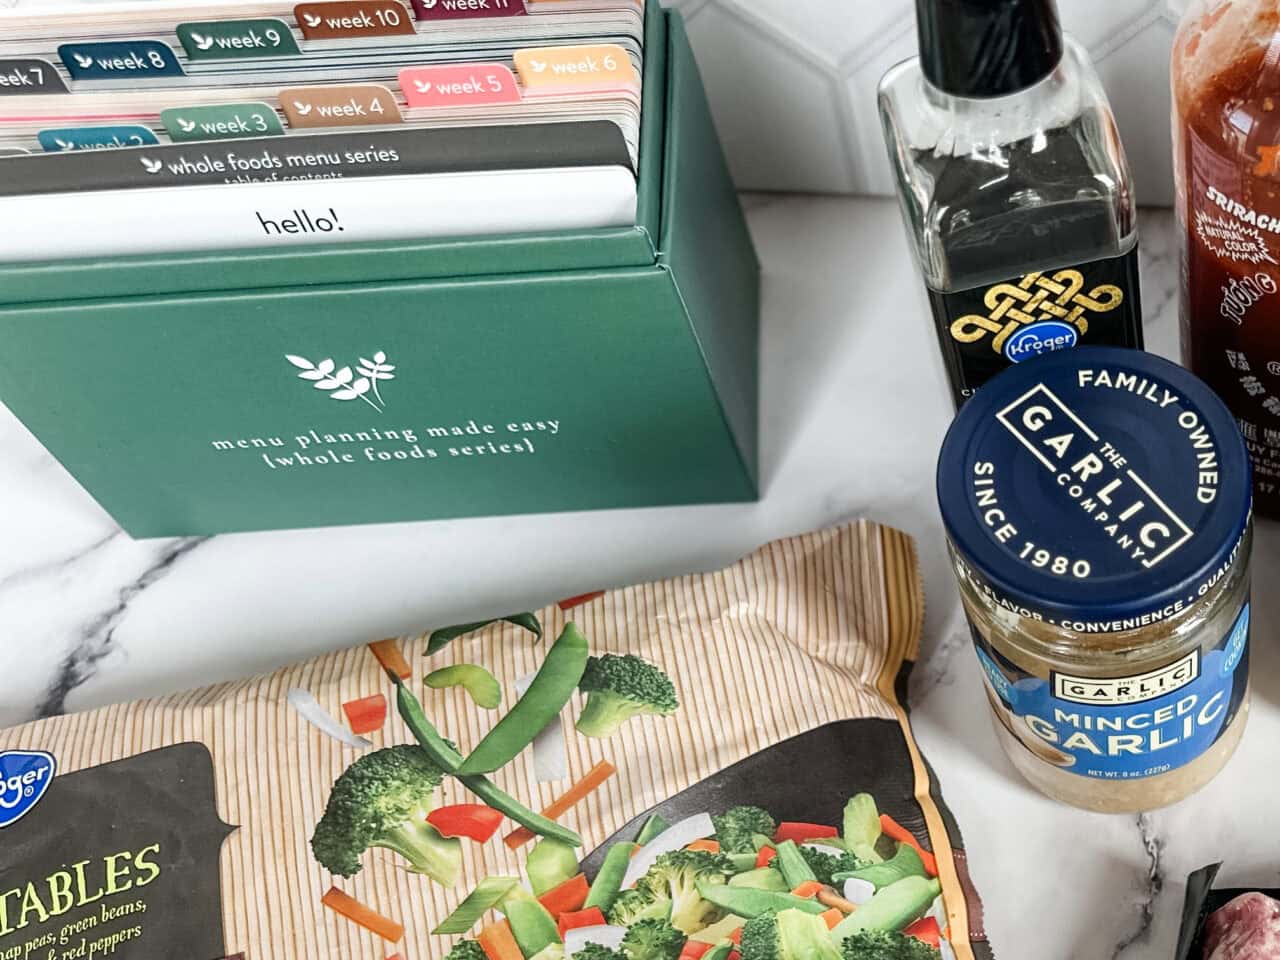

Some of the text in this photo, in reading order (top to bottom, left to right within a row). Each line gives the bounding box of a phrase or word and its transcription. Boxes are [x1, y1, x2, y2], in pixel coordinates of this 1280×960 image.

[325, 9, 401, 30] week 10
[215, 30, 281, 50] week 9
[97, 52, 165, 71] week 8
[551, 54, 617, 74] week 6
[0, 67, 43, 86] eek 7
[435, 75, 502, 96] week 5
[316, 98, 384, 118] week 4
[200, 114, 268, 135] week 3
[167, 145, 400, 175] whole foods menu series
[256, 208, 344, 235] hello!
[1224, 240, 1260, 252] COLOR
[1010, 332, 1073, 355] Kroger
[212, 418, 561, 451] menu planning made easy
[1077, 369, 1179, 409] FAMILY
[1177, 411, 1218, 504] OWNED
[261, 437, 537, 469] (whole foods series)
[1099, 442, 1128, 470] THE
[1022, 404, 1171, 549] GARLIC
[973, 461, 1019, 543] SINCE
[1018, 542, 1091, 579] 1980
[1056, 473, 1145, 560] COMPANY
[1061, 601, 1185, 633] CONVENIENCE
[1070, 668, 1185, 697] GARLIC
[1023, 690, 1225, 757] GARLIC
[1053, 694, 1199, 731] MINCED
[1088, 768, 1103, 777] NET
[24, 898, 147, 960] peas, green beans,
[88, 924, 142, 956] peppers
